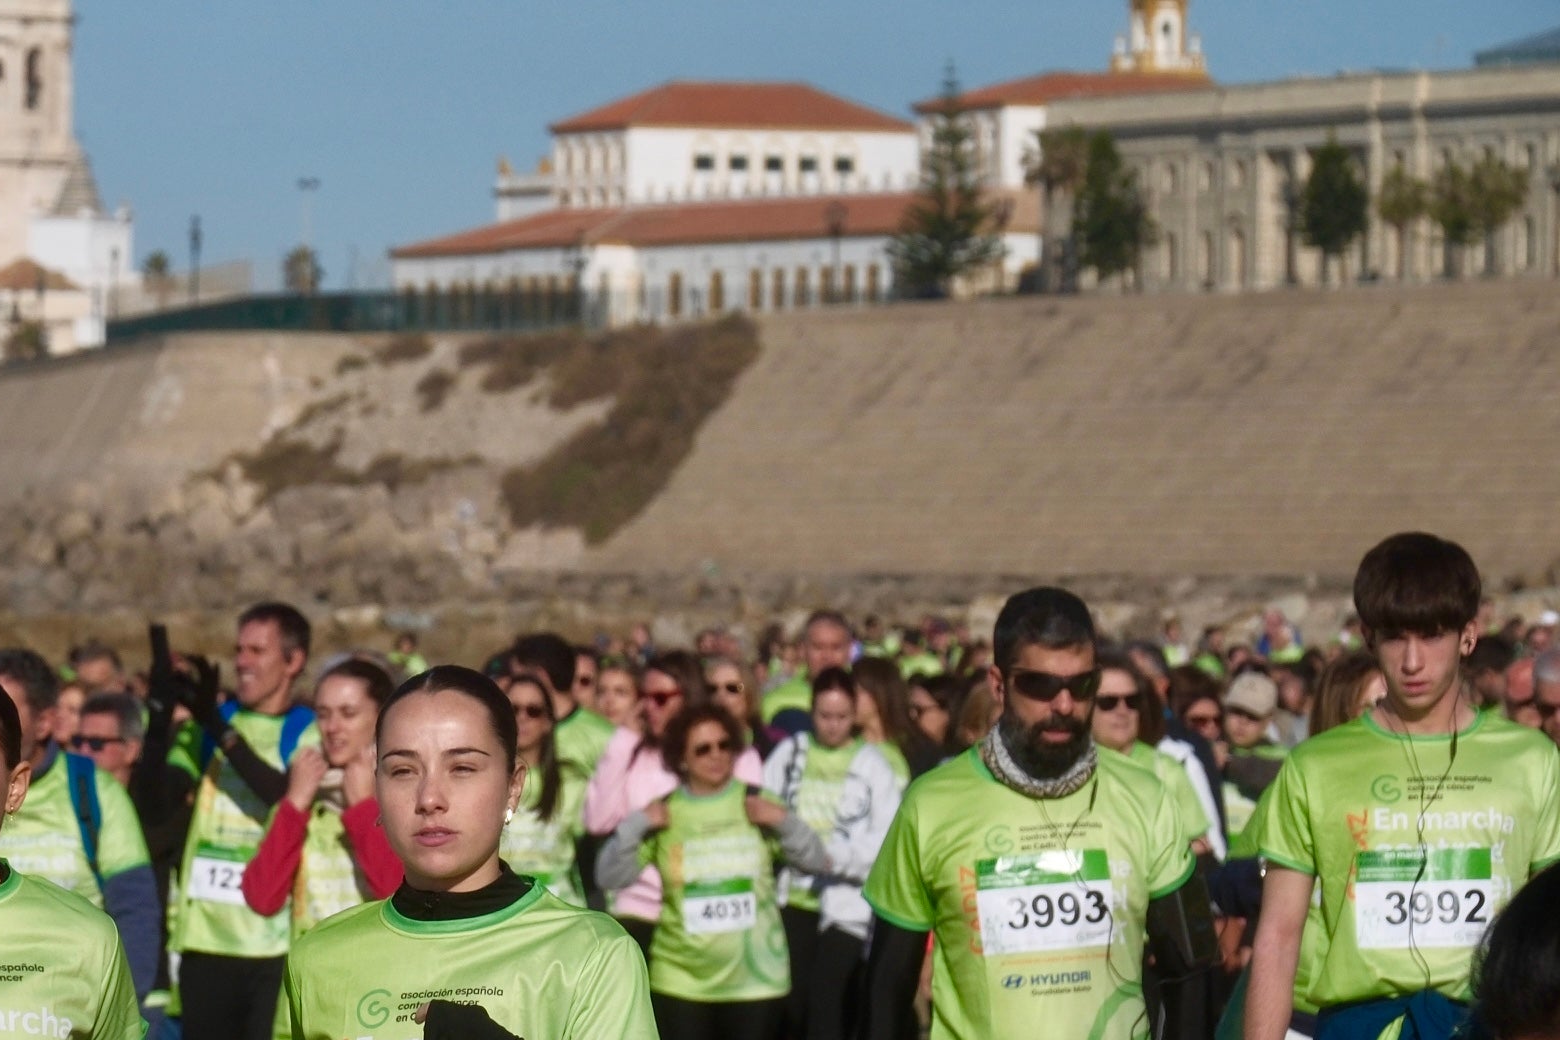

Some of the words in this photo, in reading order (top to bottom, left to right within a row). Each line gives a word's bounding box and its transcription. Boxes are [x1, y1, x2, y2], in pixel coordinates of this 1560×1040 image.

[1374, 808, 1409, 831] En
[1419, 806, 1516, 835] marcha
[702, 899, 752, 920] 4031
[1007, 890, 1108, 930] 3993
[1385, 889, 1488, 925] 3992
[1030, 969, 1092, 985] HYUNDAI
[400, 988, 453, 1000] asociación
[455, 985, 504, 998] española
[395, 1014, 409, 1023] en
